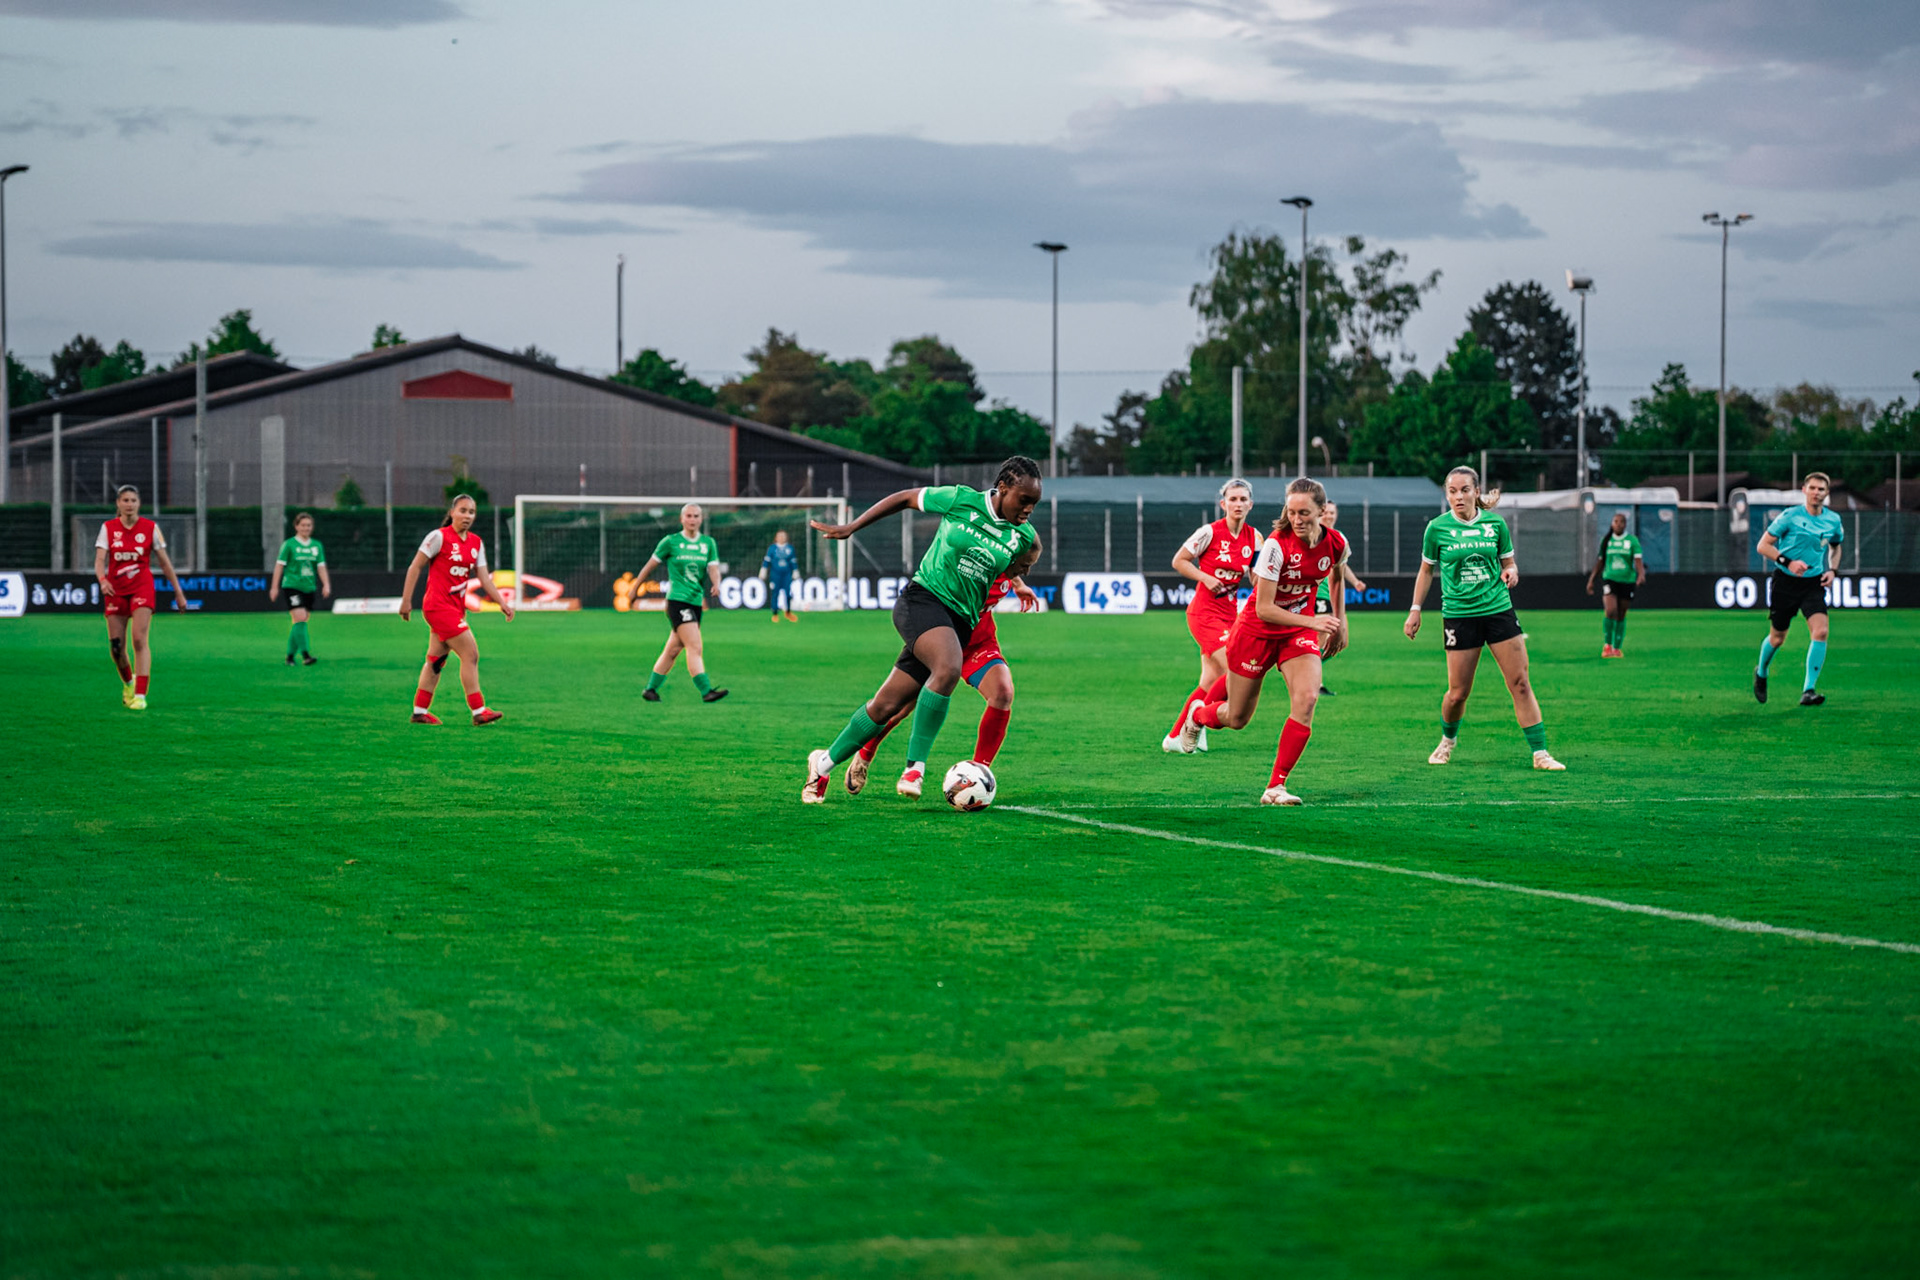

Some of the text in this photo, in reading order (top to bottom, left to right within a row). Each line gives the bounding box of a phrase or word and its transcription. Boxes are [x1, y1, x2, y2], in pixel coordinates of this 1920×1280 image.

[31, 583, 48, 606] à
[50, 582, 87, 606] vie
[218, 577, 240, 591] EN
[242, 576, 267, 592] CH
[719, 576, 768, 610] GO
[1150, 583, 1165, 606] à
[1714, 576, 1758, 608] GO
